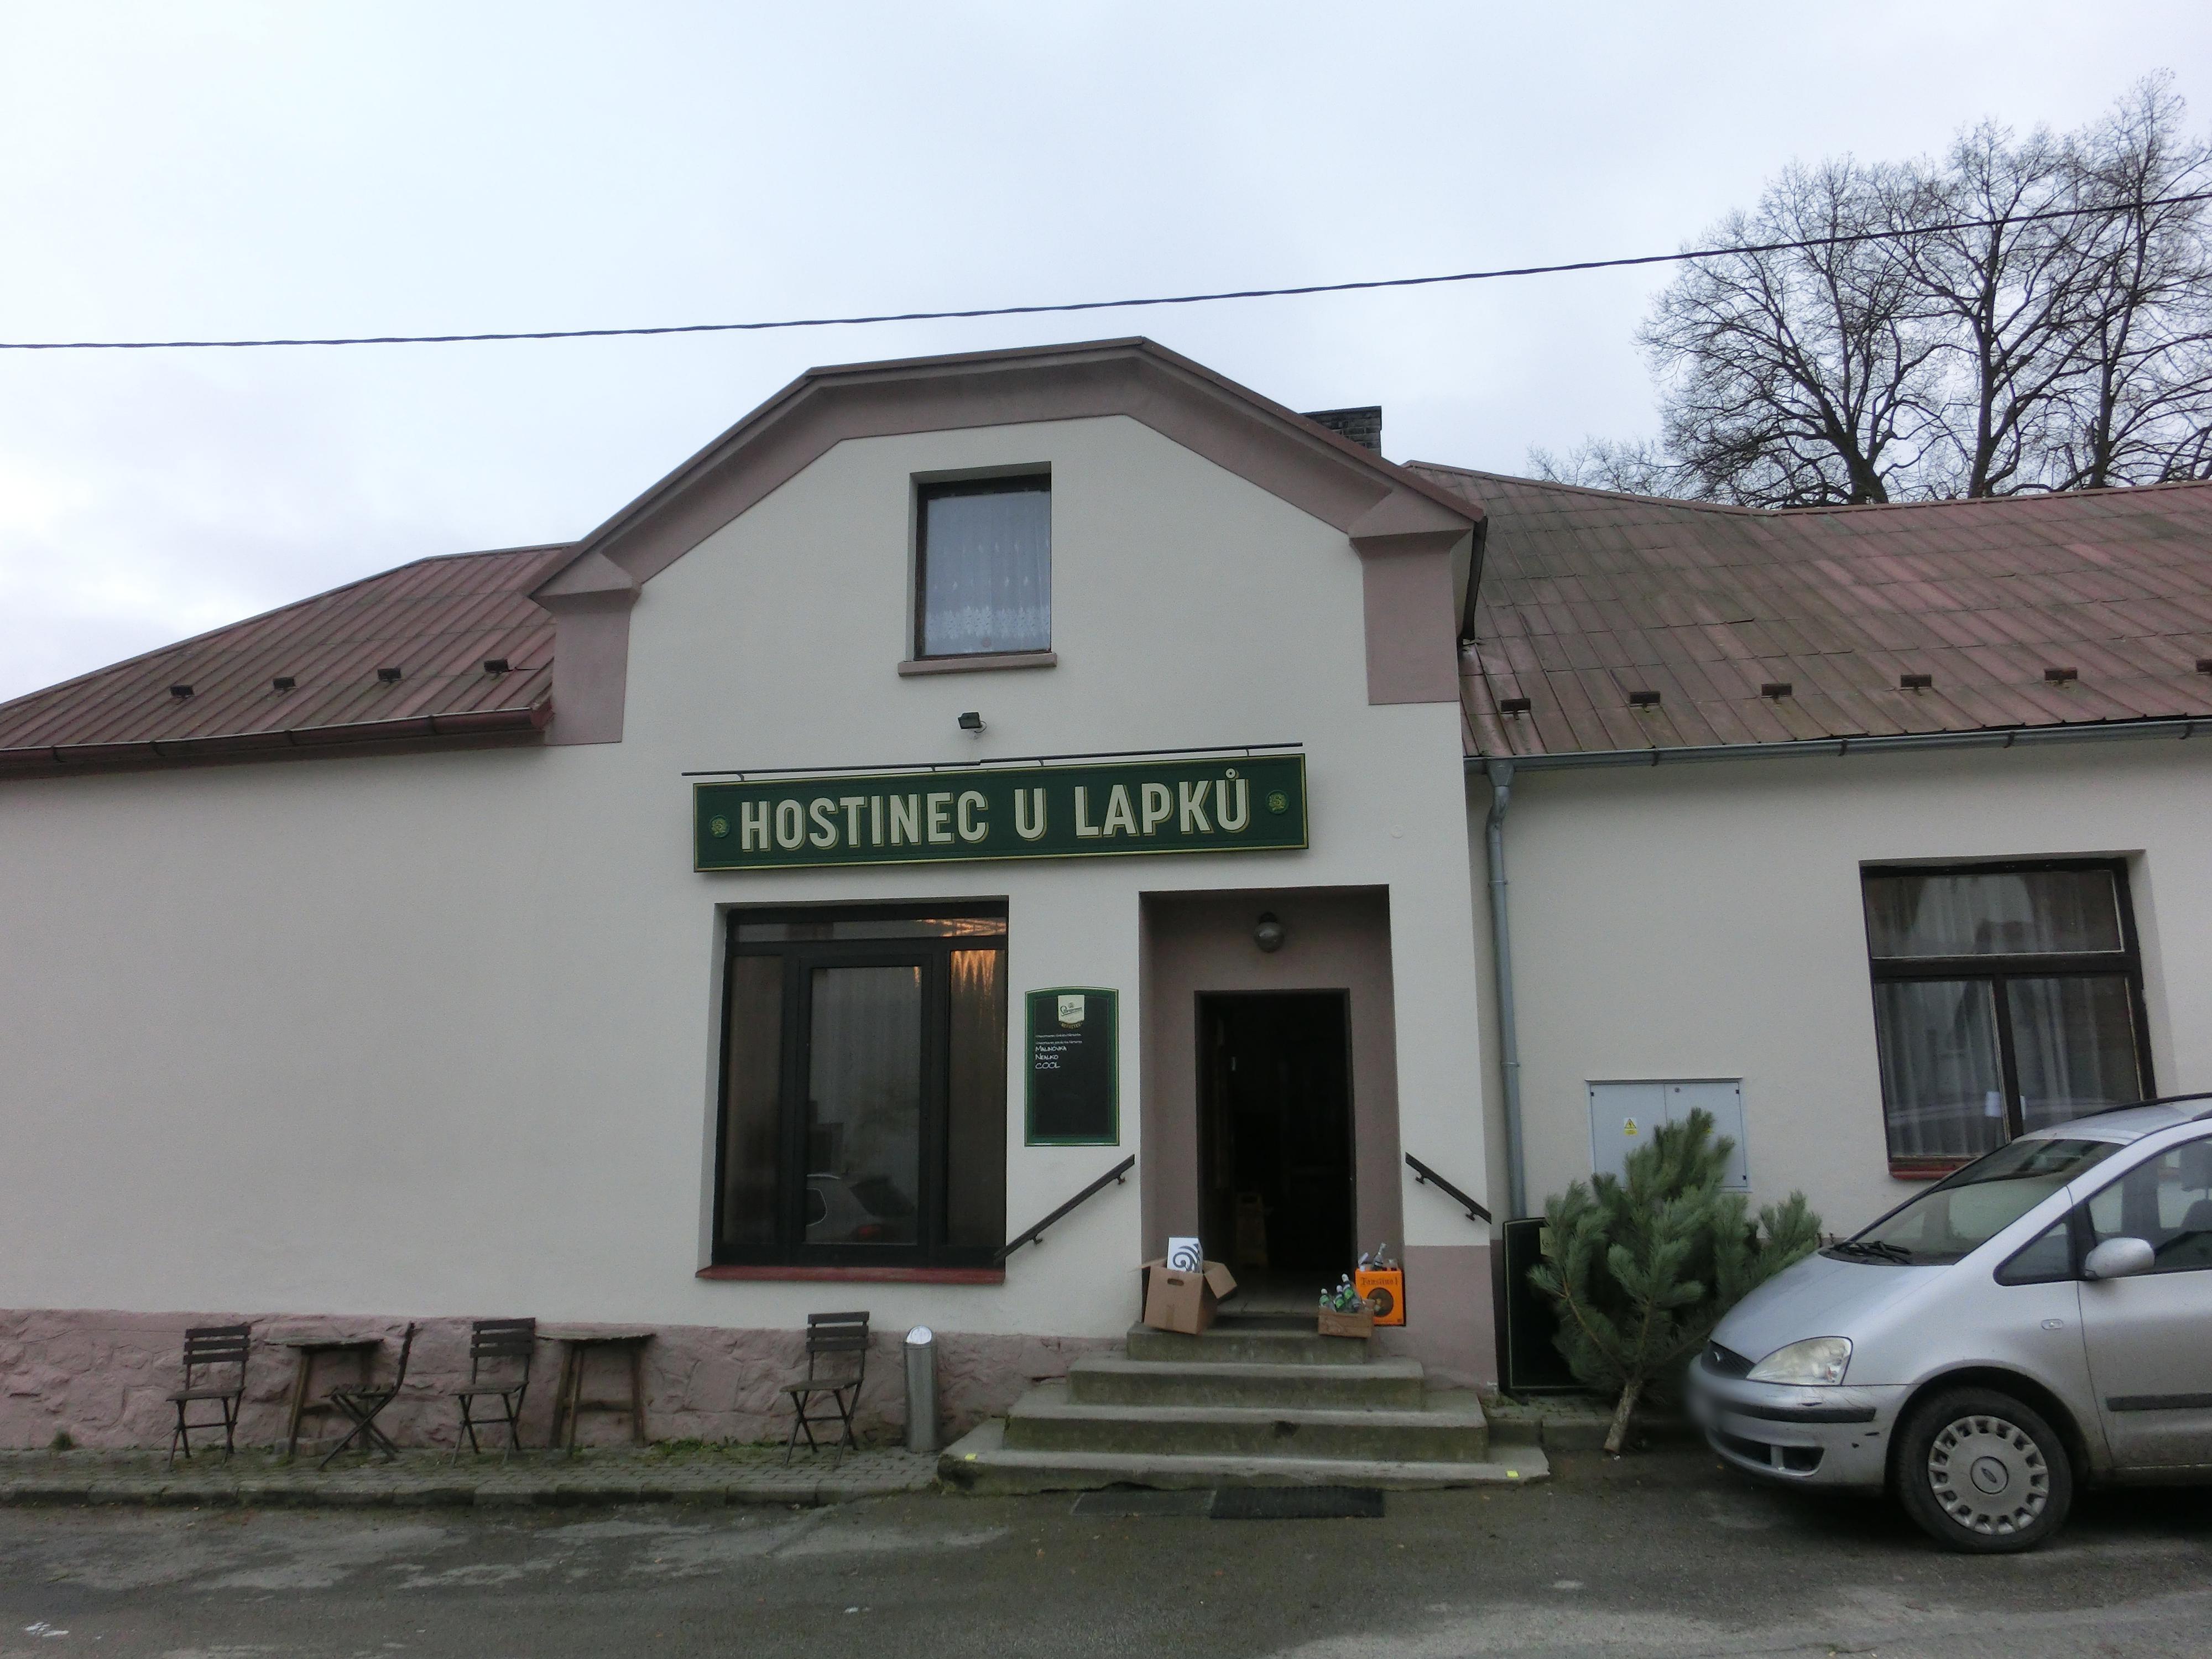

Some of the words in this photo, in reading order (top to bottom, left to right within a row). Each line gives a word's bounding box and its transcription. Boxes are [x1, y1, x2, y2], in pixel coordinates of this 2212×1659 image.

[741, 791, 989, 852] HOSTINEC
[1014, 787, 1047, 842] U
[1074, 768, 1250, 839] LAPKŮ
